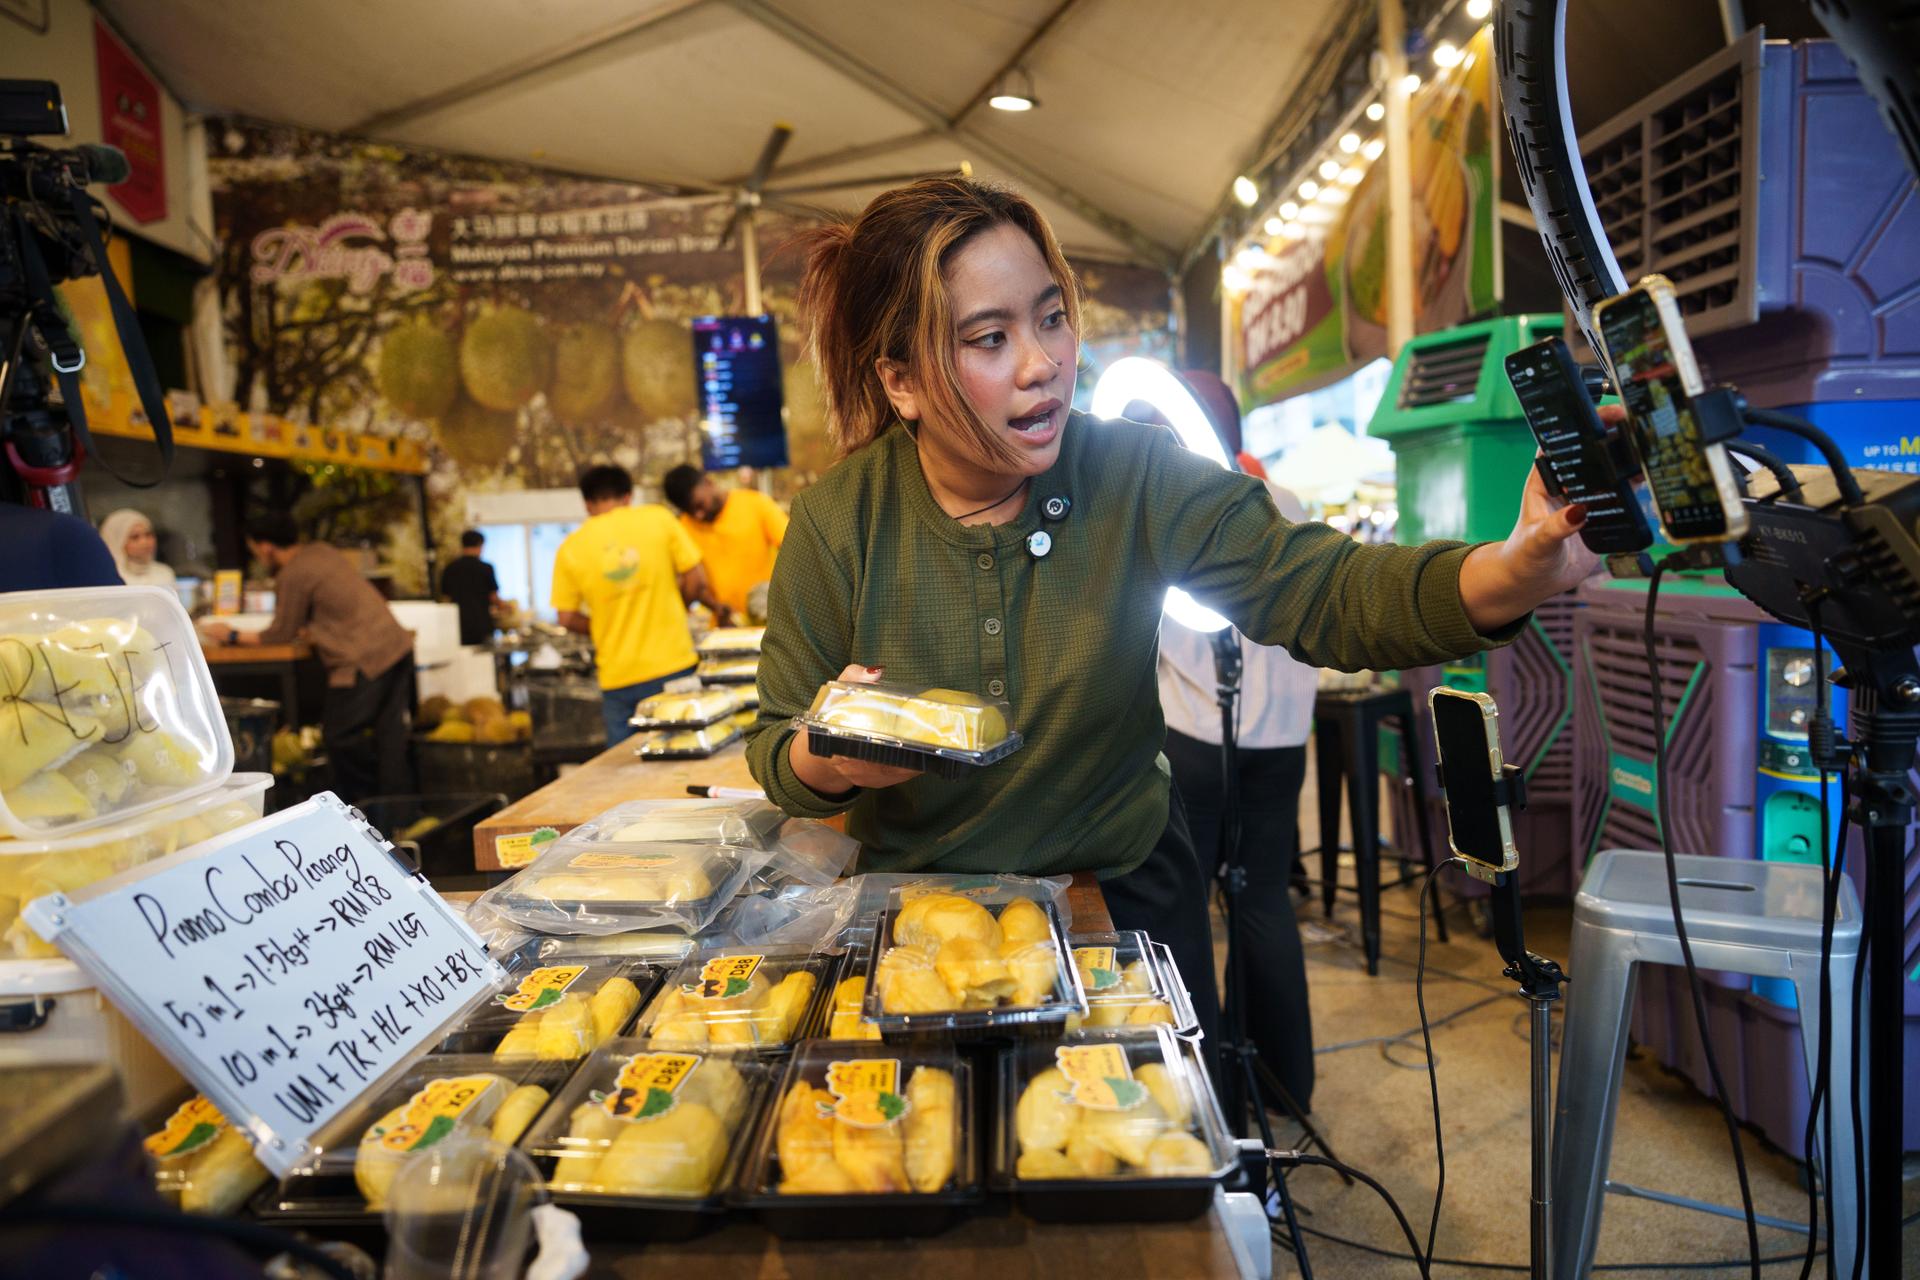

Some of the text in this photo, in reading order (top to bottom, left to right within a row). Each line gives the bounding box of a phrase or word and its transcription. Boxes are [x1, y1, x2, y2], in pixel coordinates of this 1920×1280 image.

[450, 244, 531, 263] Malaysia
[532, 239, 613, 259] Premium
[615, 236, 677, 256] Durian
[552, 972, 573, 985] XO
[163, 1001, 207, 1039] 5
[220, 1050, 258, 1088] 10
